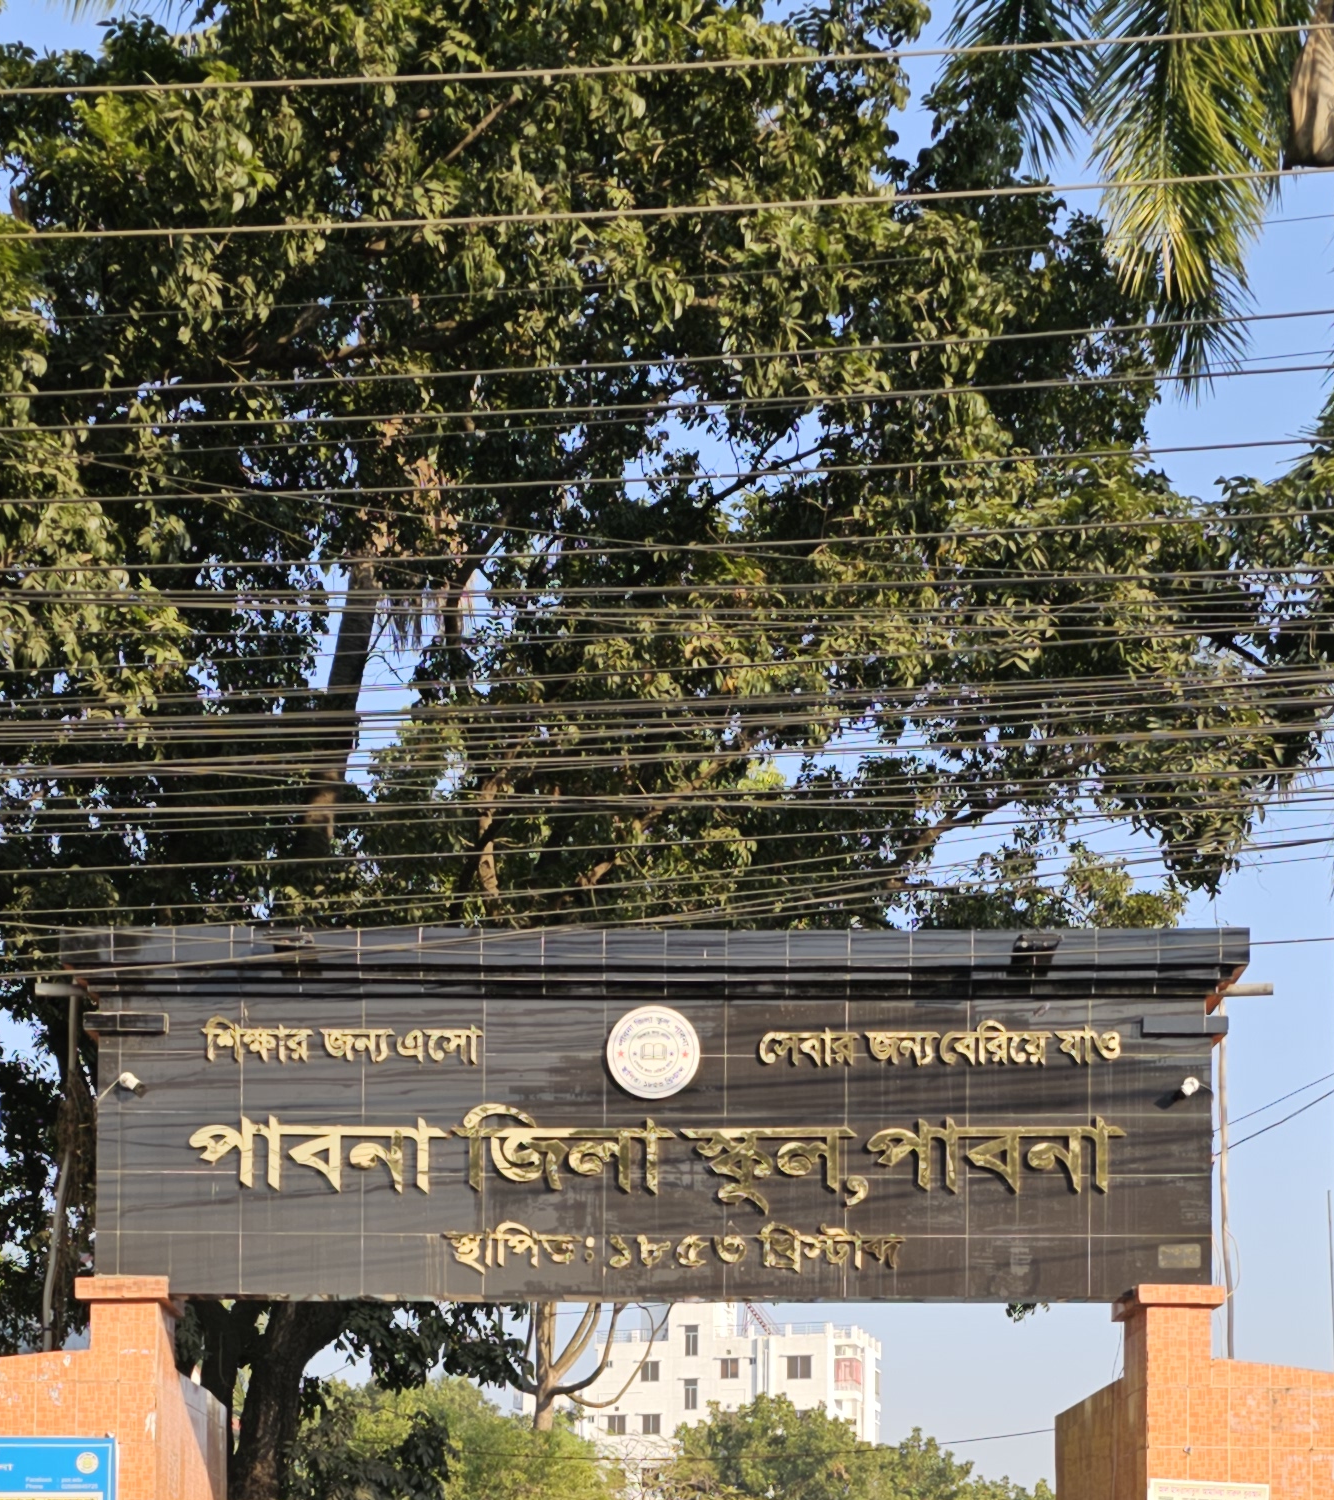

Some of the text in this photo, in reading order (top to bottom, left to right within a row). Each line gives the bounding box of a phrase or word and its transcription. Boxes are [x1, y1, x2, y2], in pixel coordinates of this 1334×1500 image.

[201, 1014, 483, 1066] শিক্ষার জন্য এসো
[759, 1019, 1122, 1067] সেবার জন্য বেরিয়ে যাও
[188, 1102, 1127, 1217] পাবনা জিলা স্কুল, পাবনা
[609, 1231, 748, 1269] ১৮৫৩
